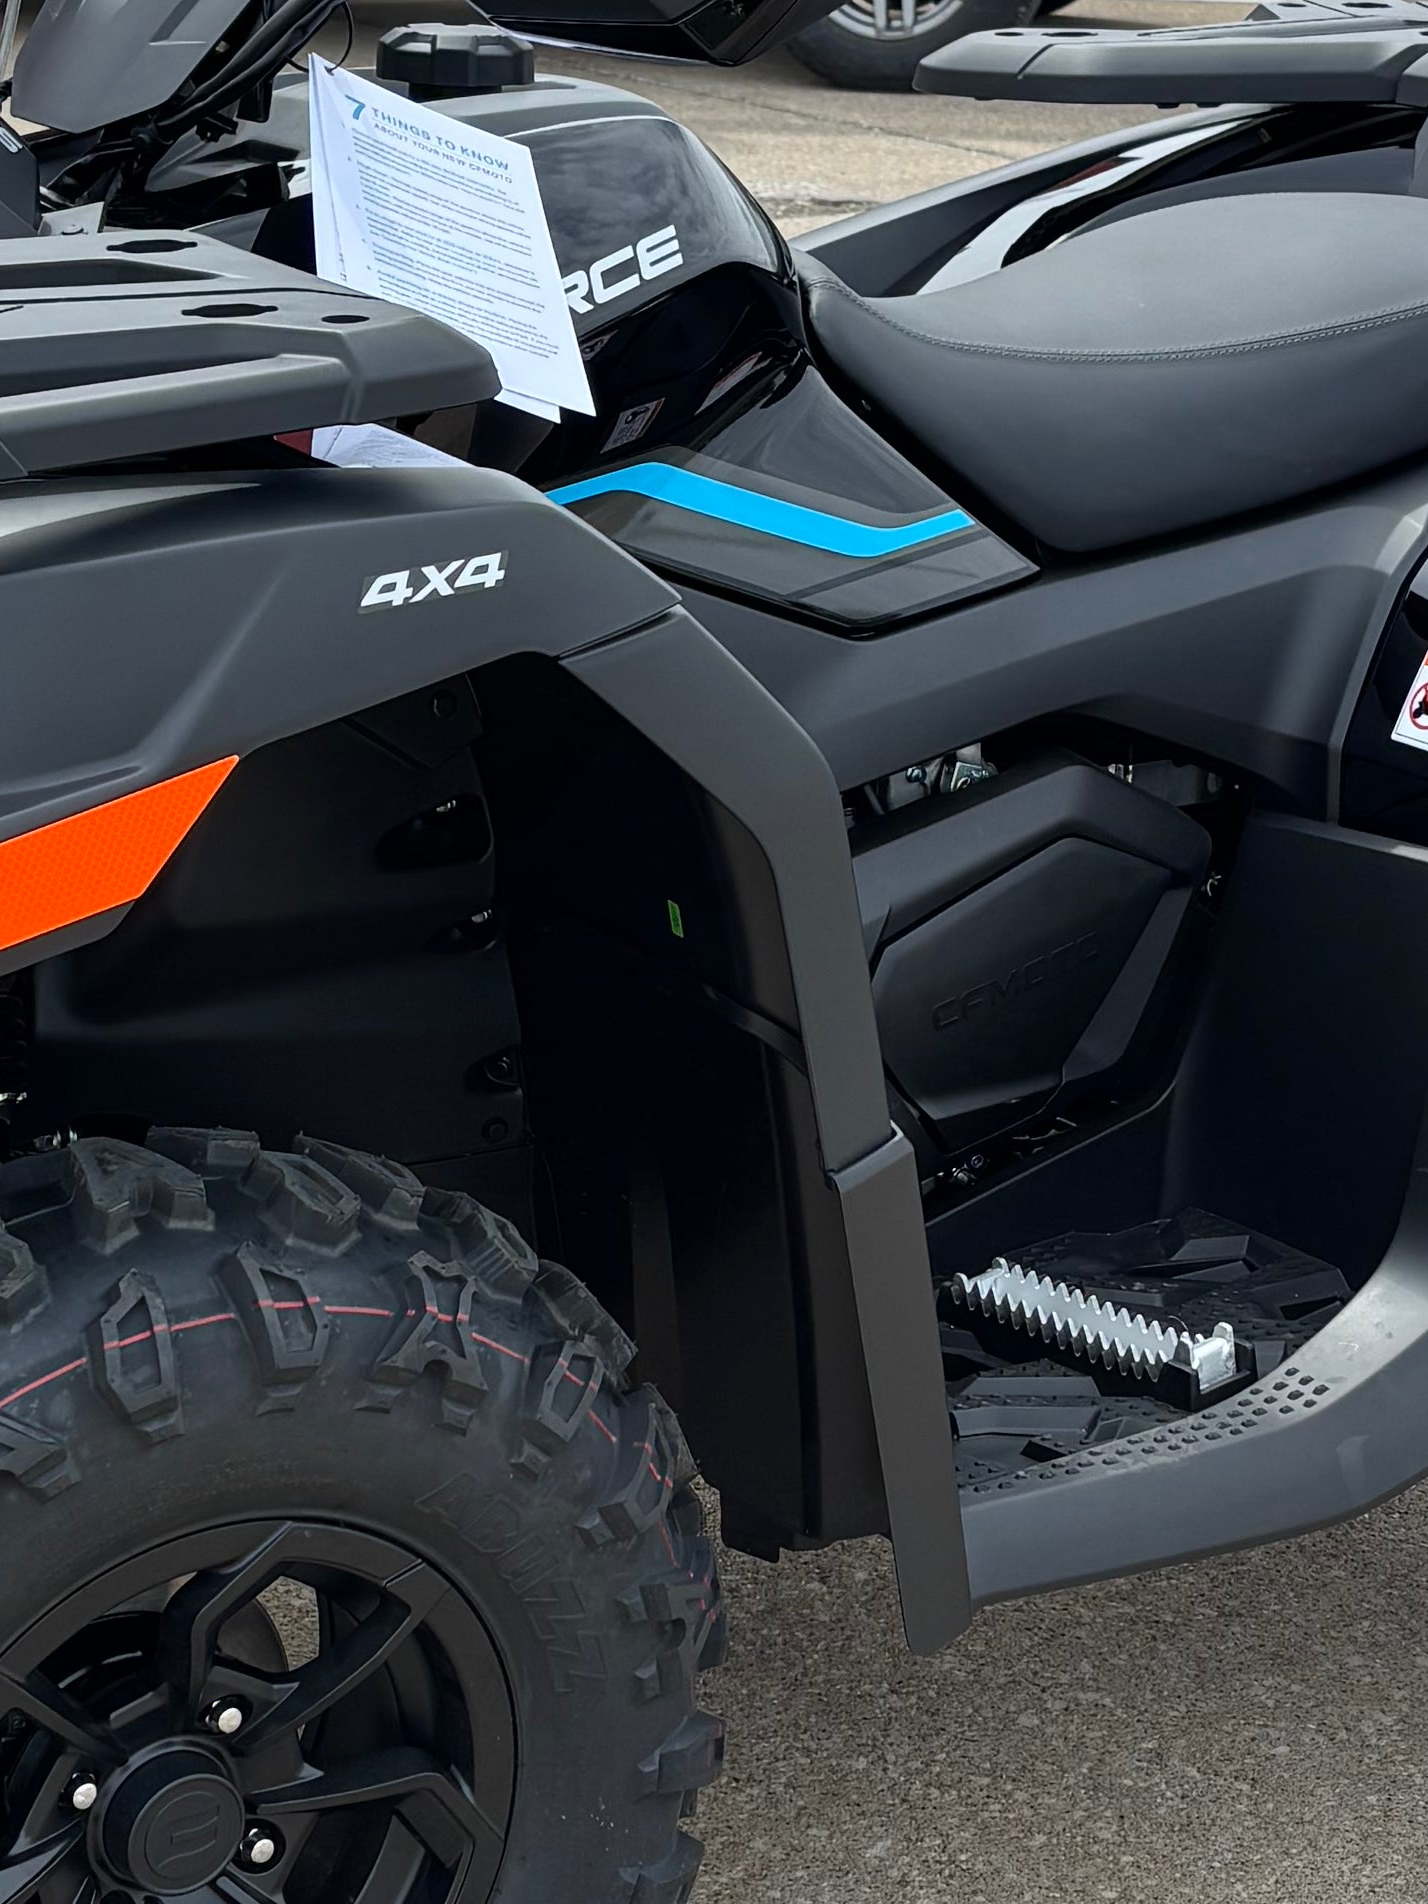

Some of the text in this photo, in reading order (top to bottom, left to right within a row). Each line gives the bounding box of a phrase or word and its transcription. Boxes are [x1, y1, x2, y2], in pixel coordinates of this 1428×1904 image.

[345, 94, 509, 171] 7 THINGS TO KNOW
[373, 123, 409, 143] ABOUT
